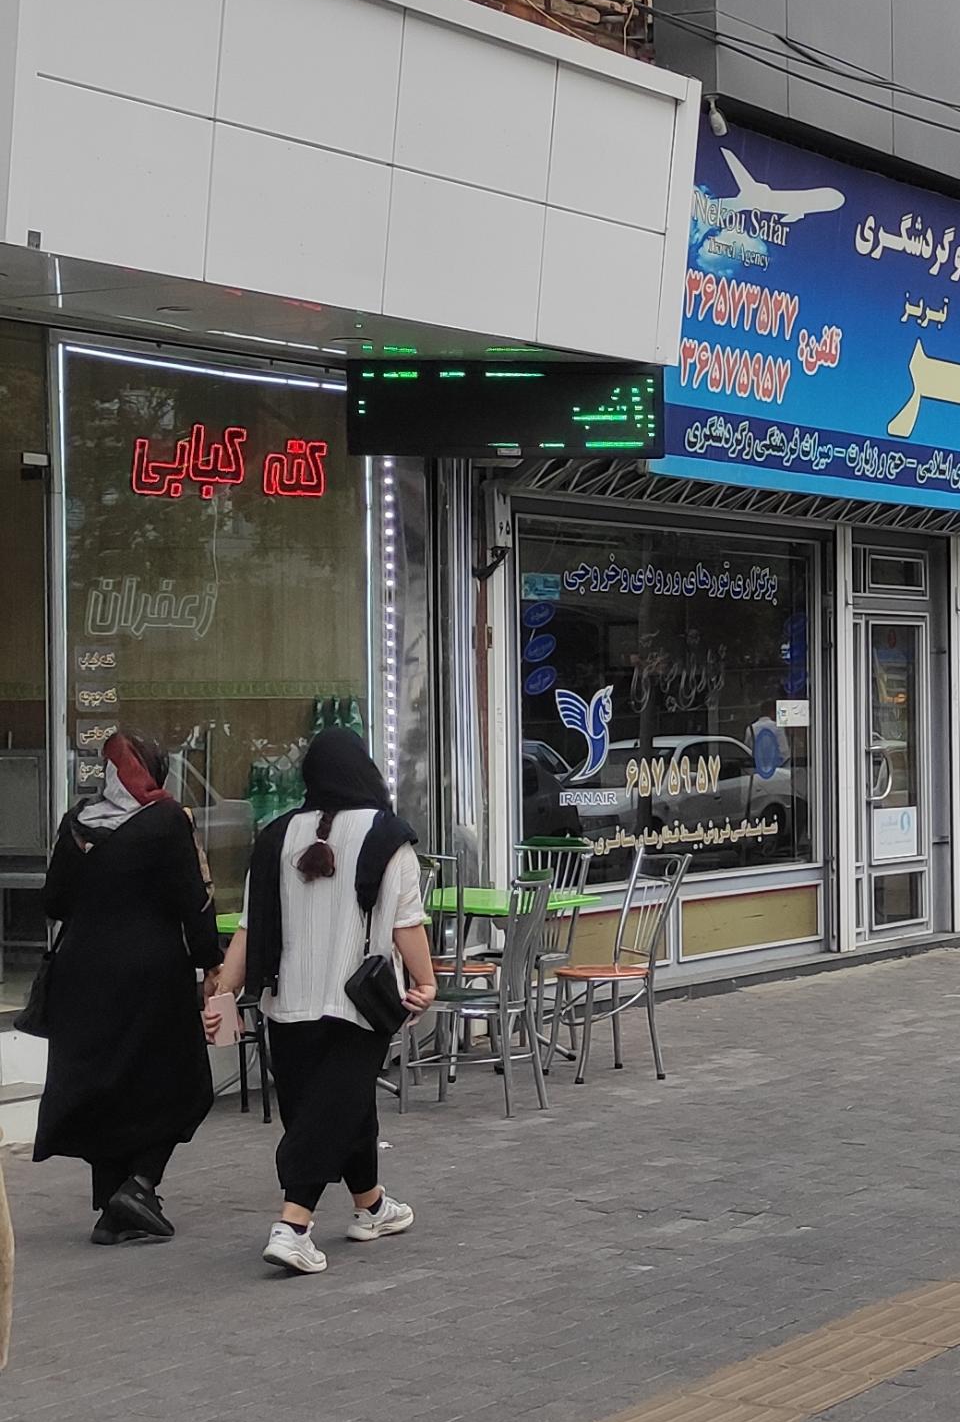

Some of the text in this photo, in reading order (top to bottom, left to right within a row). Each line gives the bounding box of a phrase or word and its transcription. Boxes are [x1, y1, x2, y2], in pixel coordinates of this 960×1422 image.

[694, 190, 790, 246] Nekou Safar
[707, 236, 771, 271] Travel Agency
[855, 213, 956, 276] گردشگری
[685, 268, 799, 341] ۳۶۵۷۳۵۲۷
[901, 290, 949, 329] تبریز
[679, 336, 791, 405] ۳۶۵۷۵۹۵۷
[685, 416, 749, 457] گردشگری
[753, 426, 800, 466] فرهنگی
[800, 431, 834, 470] میراث
[132, 423, 328, 500] کته کبابی
[846, 440, 878, 477] زیارت
[916, 449, 954, 484] اسلامی
[563, 552, 621, 596] خروجی
[630, 563, 682, 596] ورودی
[682, 561, 730, 598] تورهای
[729, 565, 778, 606] برگزاری
[85, 577, 218, 639] زعفران
[625, 755, 721, 797] ۶۵۷ ۵۹ ۵۷
[559, 791, 618, 807] IRANAIR
[703, 816, 731, 845] فروش
[730, 814, 778, 842] نمایندگی
